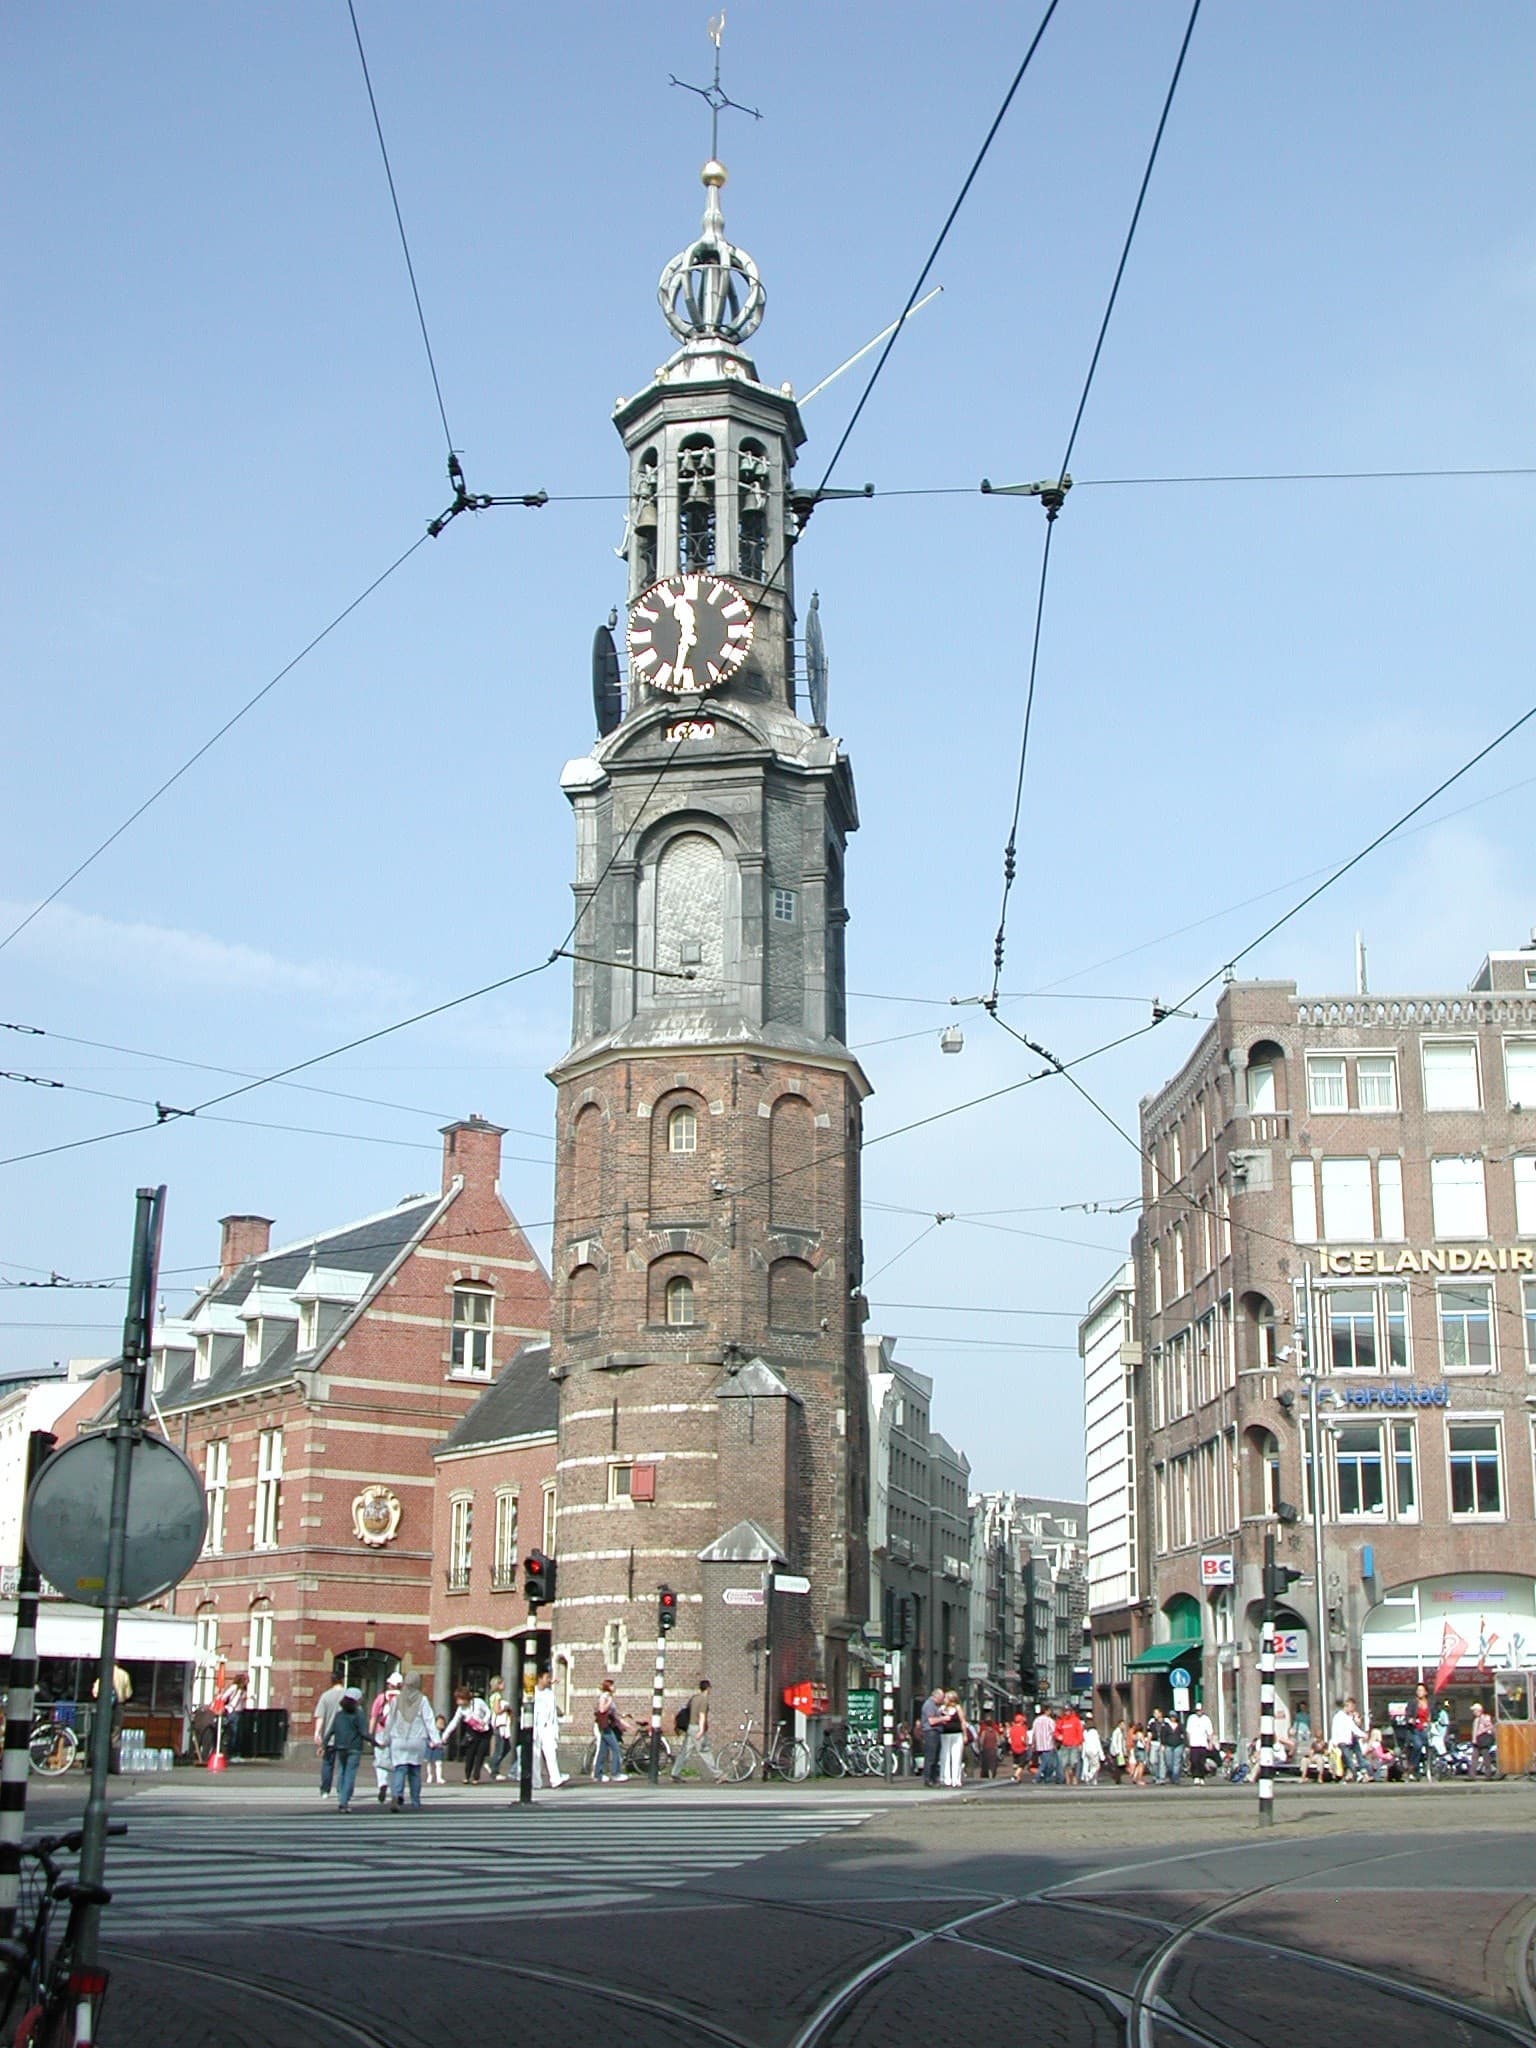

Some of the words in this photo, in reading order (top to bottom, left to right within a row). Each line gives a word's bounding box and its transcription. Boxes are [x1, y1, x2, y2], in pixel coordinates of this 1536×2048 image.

[665, 721, 715, 742] 1620
[1319, 1246, 1533, 1273] ICELANDAIR
[1344, 1380, 1448, 1407] randstad
